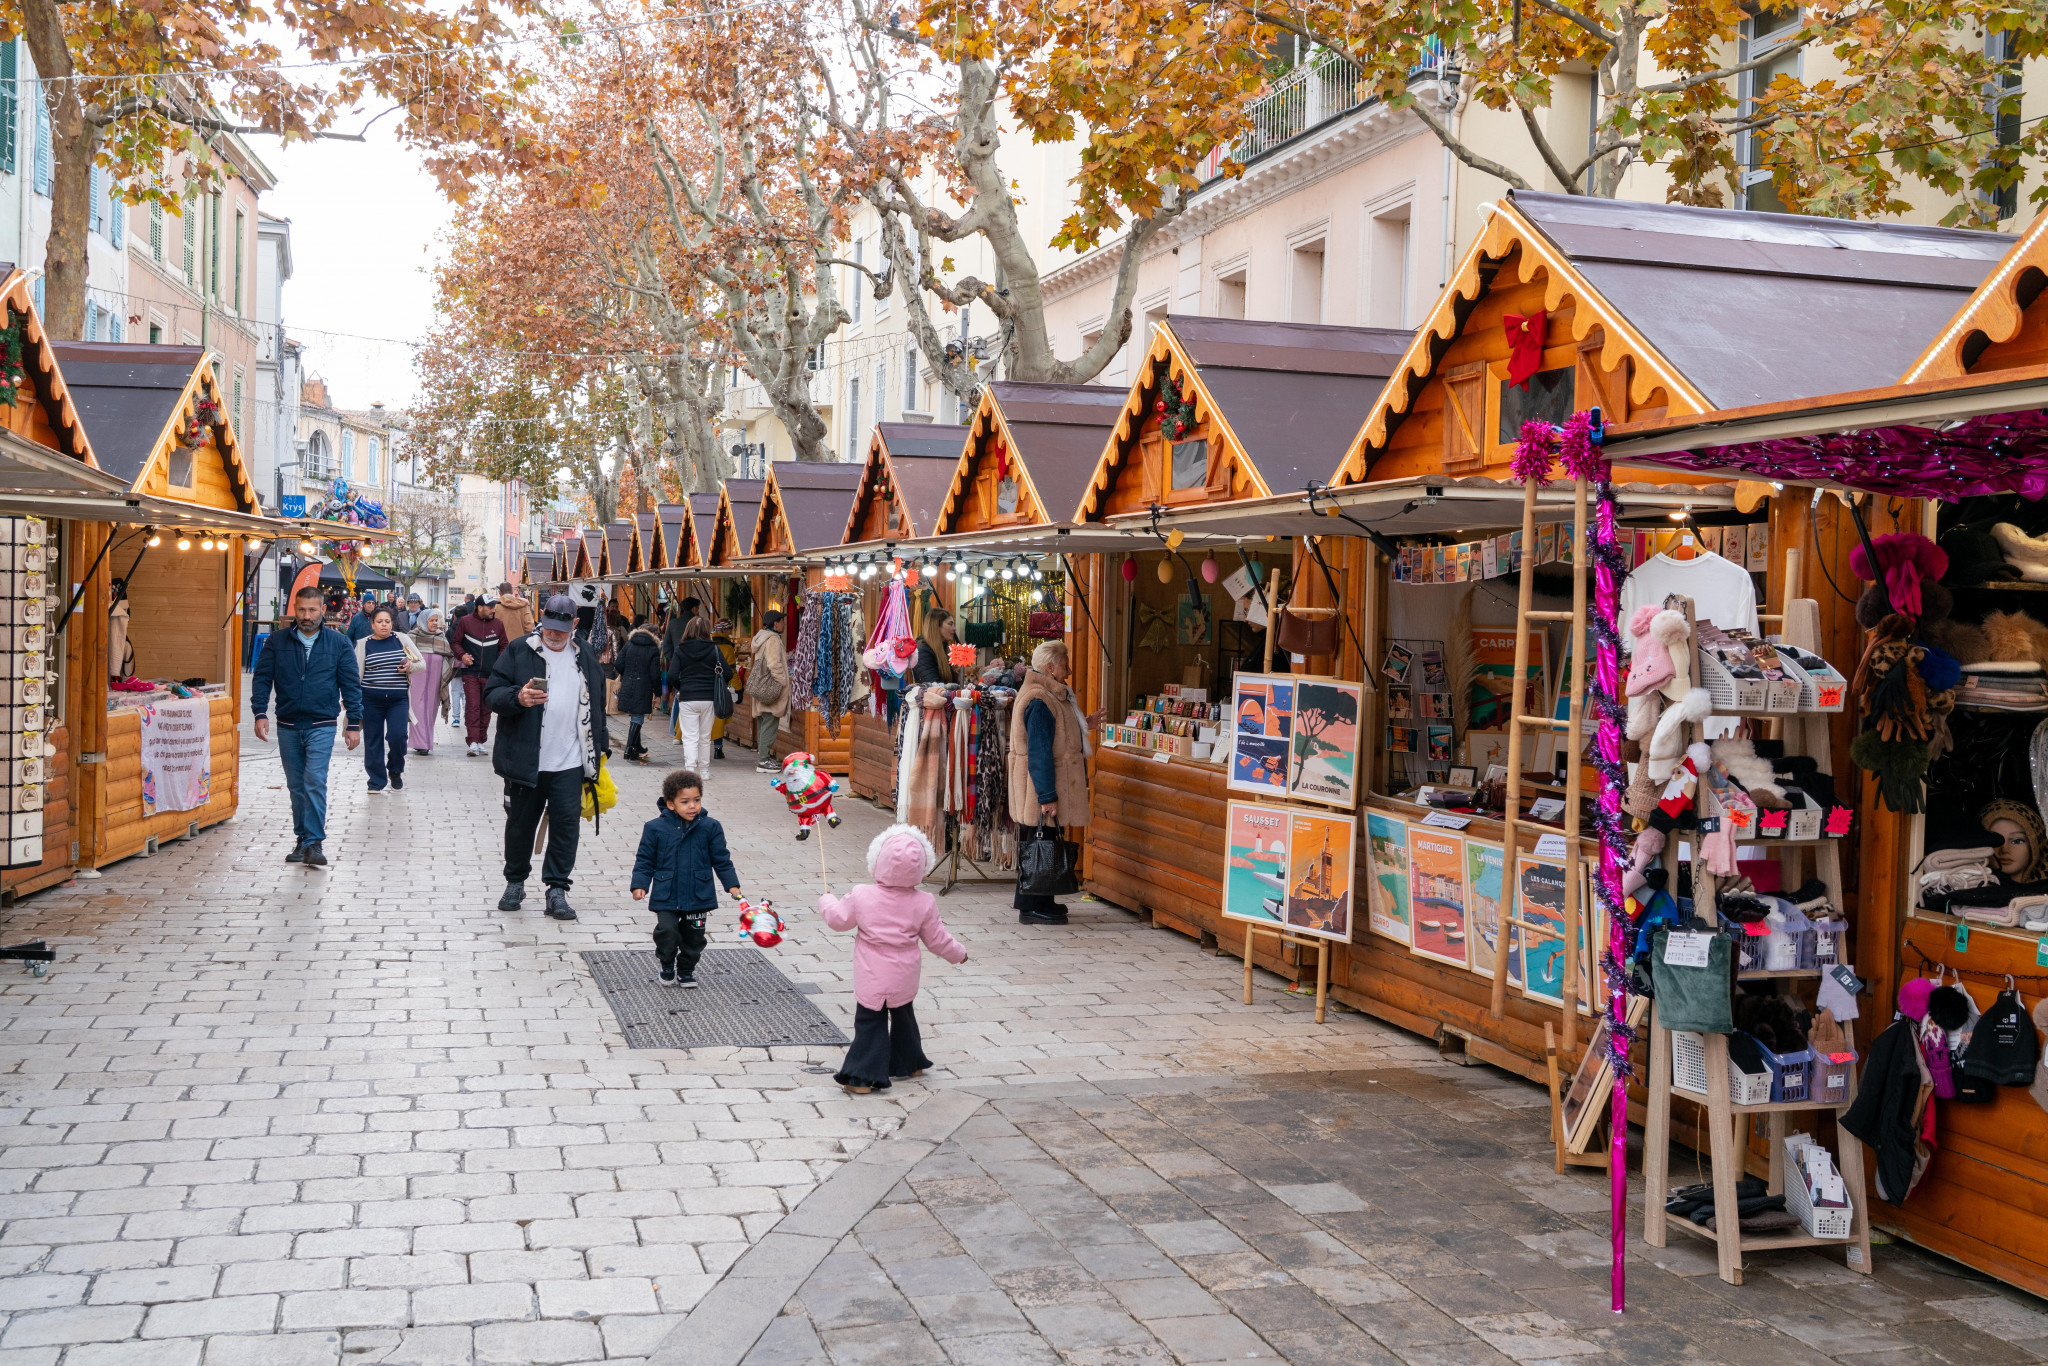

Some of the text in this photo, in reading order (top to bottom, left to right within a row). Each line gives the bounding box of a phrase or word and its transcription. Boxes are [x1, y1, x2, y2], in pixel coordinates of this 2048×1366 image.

[1479, 638, 1515, 648] CARR
[1309, 784, 1341, 795] COURONNE
[1244, 814, 1280, 827] SAUSSET
[1417, 839, 1454, 855] MARTIGUES
[1476, 852, 1485, 863] LA
[1485, 855, 1503, 867] VENIS
[1530, 875, 1540, 883] LES
[1540, 877, 1566, 888] CALANQU
